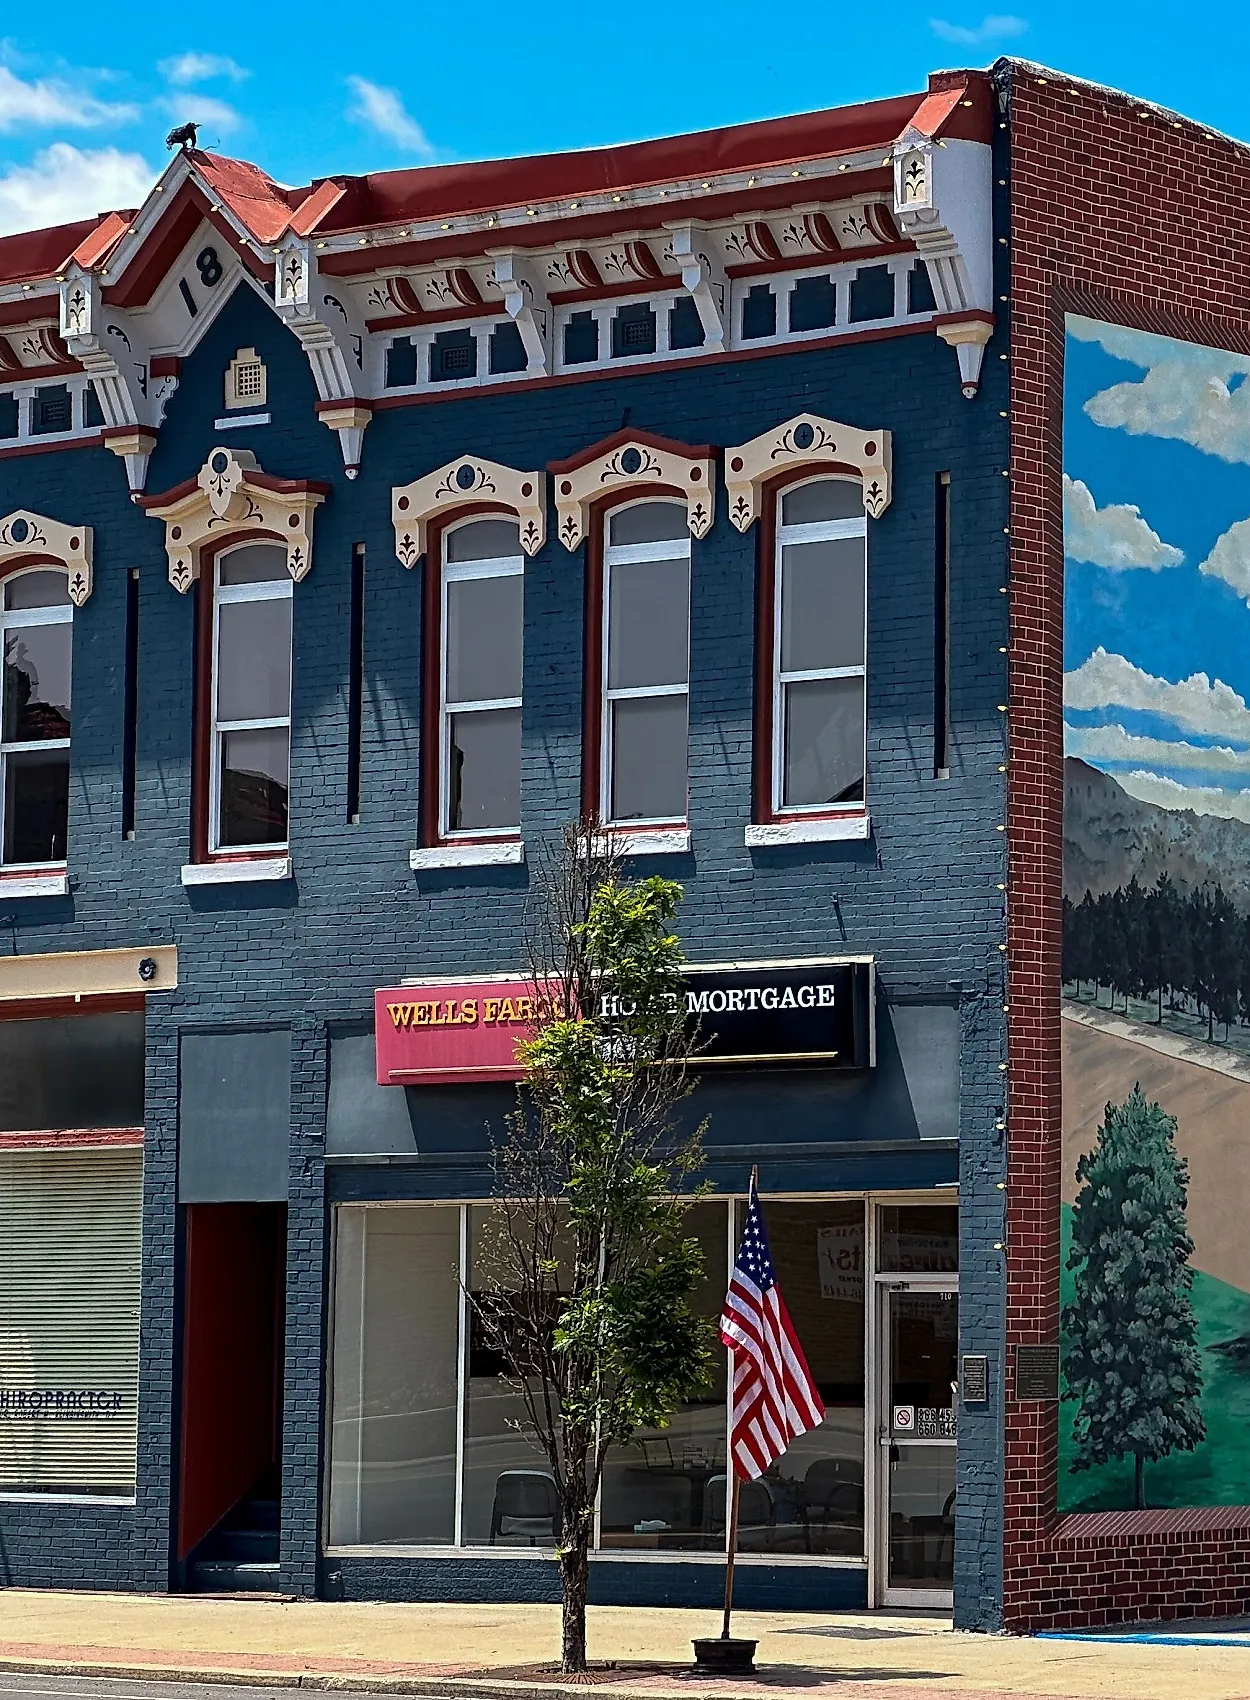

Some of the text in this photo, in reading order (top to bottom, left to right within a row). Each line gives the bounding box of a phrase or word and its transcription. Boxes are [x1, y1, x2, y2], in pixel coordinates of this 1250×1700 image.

[179, 246, 223, 318] 18
[387, 998, 477, 1028] WELLS
[600, 992, 678, 1018] HOE
[686, 984, 836, 1014] MORTGAGE
[0, 1391, 122, 1409] HIROPRACTOR
[918, 1423, 936, 1436] 660
